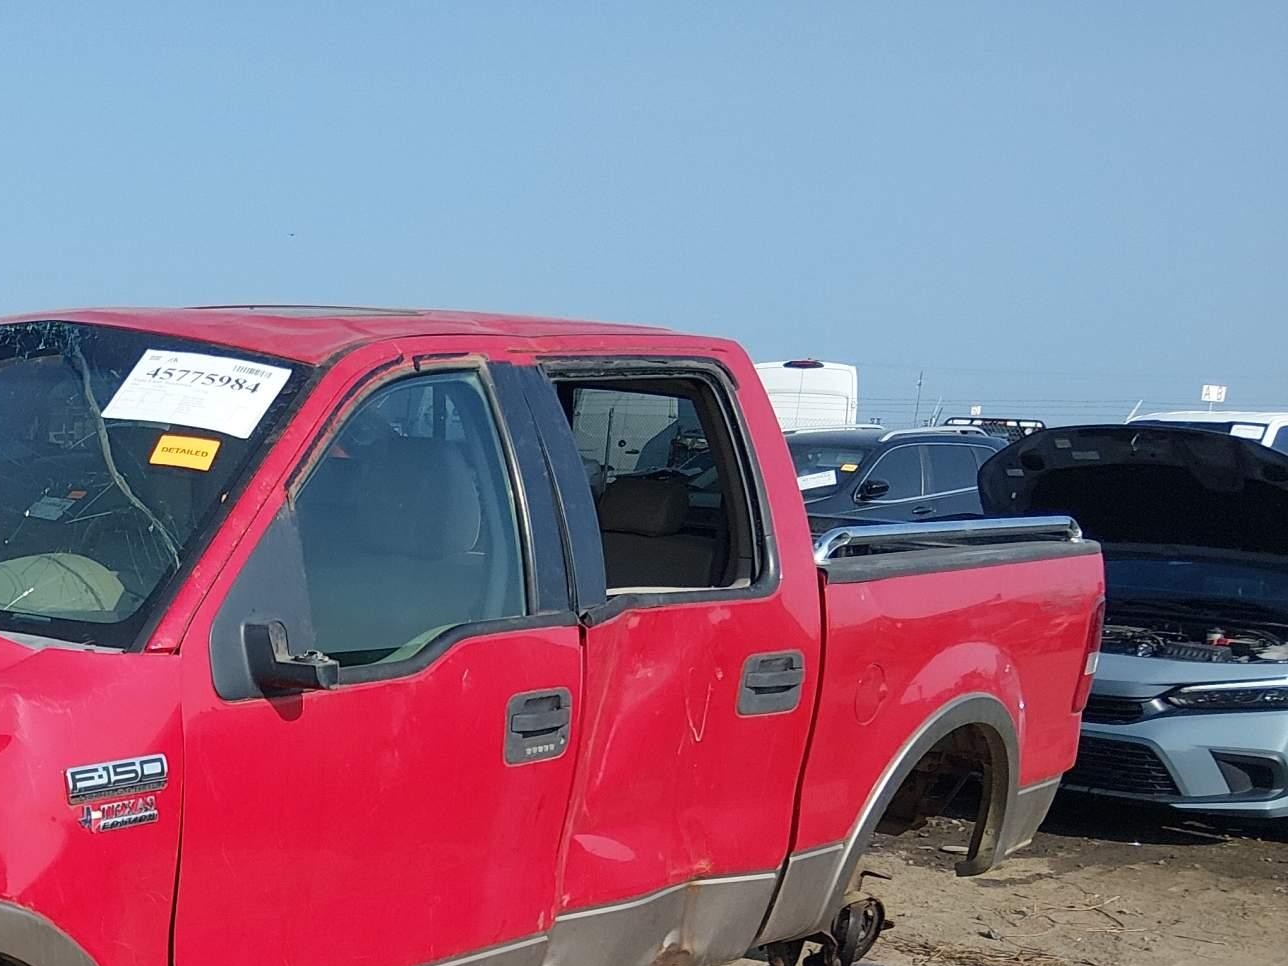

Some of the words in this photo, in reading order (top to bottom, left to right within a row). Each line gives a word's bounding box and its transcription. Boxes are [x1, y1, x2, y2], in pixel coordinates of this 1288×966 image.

[146, 366, 261, 394] 45775984
[161, 446, 209, 458] DETAILED
[100, 796, 156, 819] TEXAS
